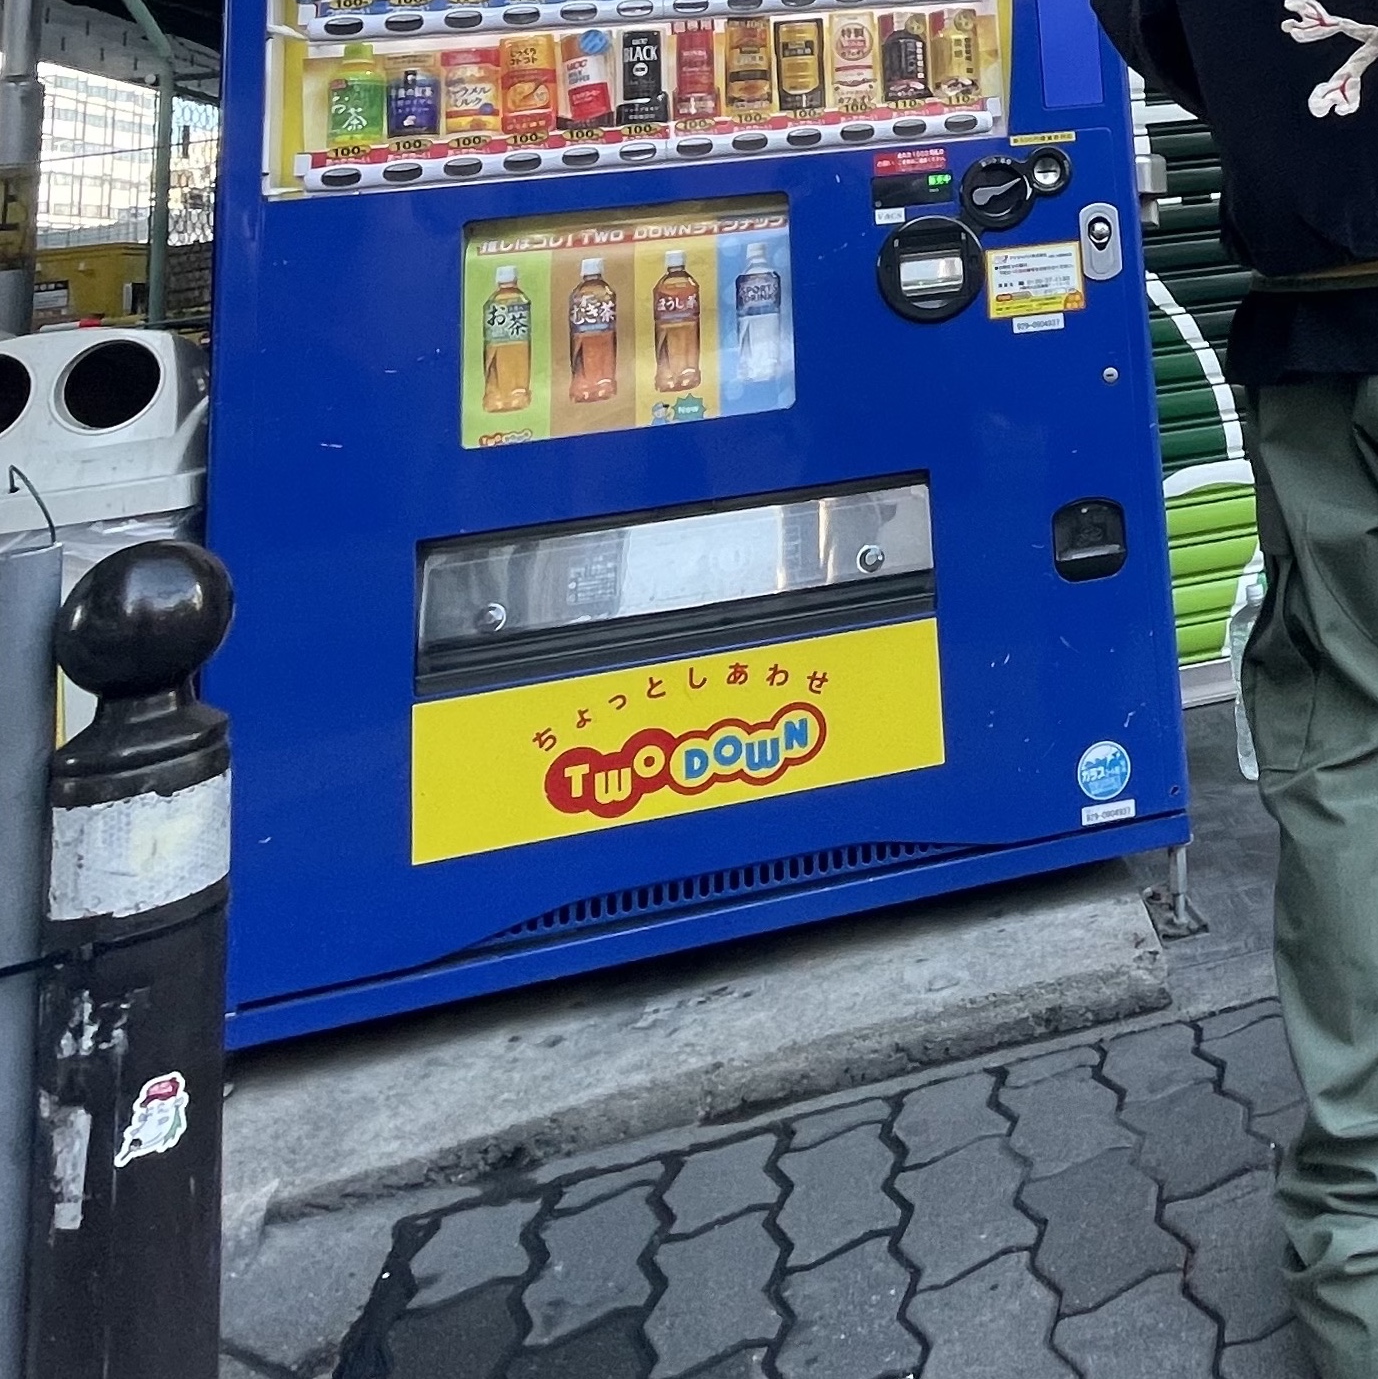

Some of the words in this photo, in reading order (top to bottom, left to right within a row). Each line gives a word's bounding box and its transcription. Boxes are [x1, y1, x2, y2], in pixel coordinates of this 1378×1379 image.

[624, 45, 658, 63] BLACK
[532, 662, 829, 751] ちょっとしあわせ
[563, 744, 666, 804] TWO
[684, 718, 808, 780] DOWN
